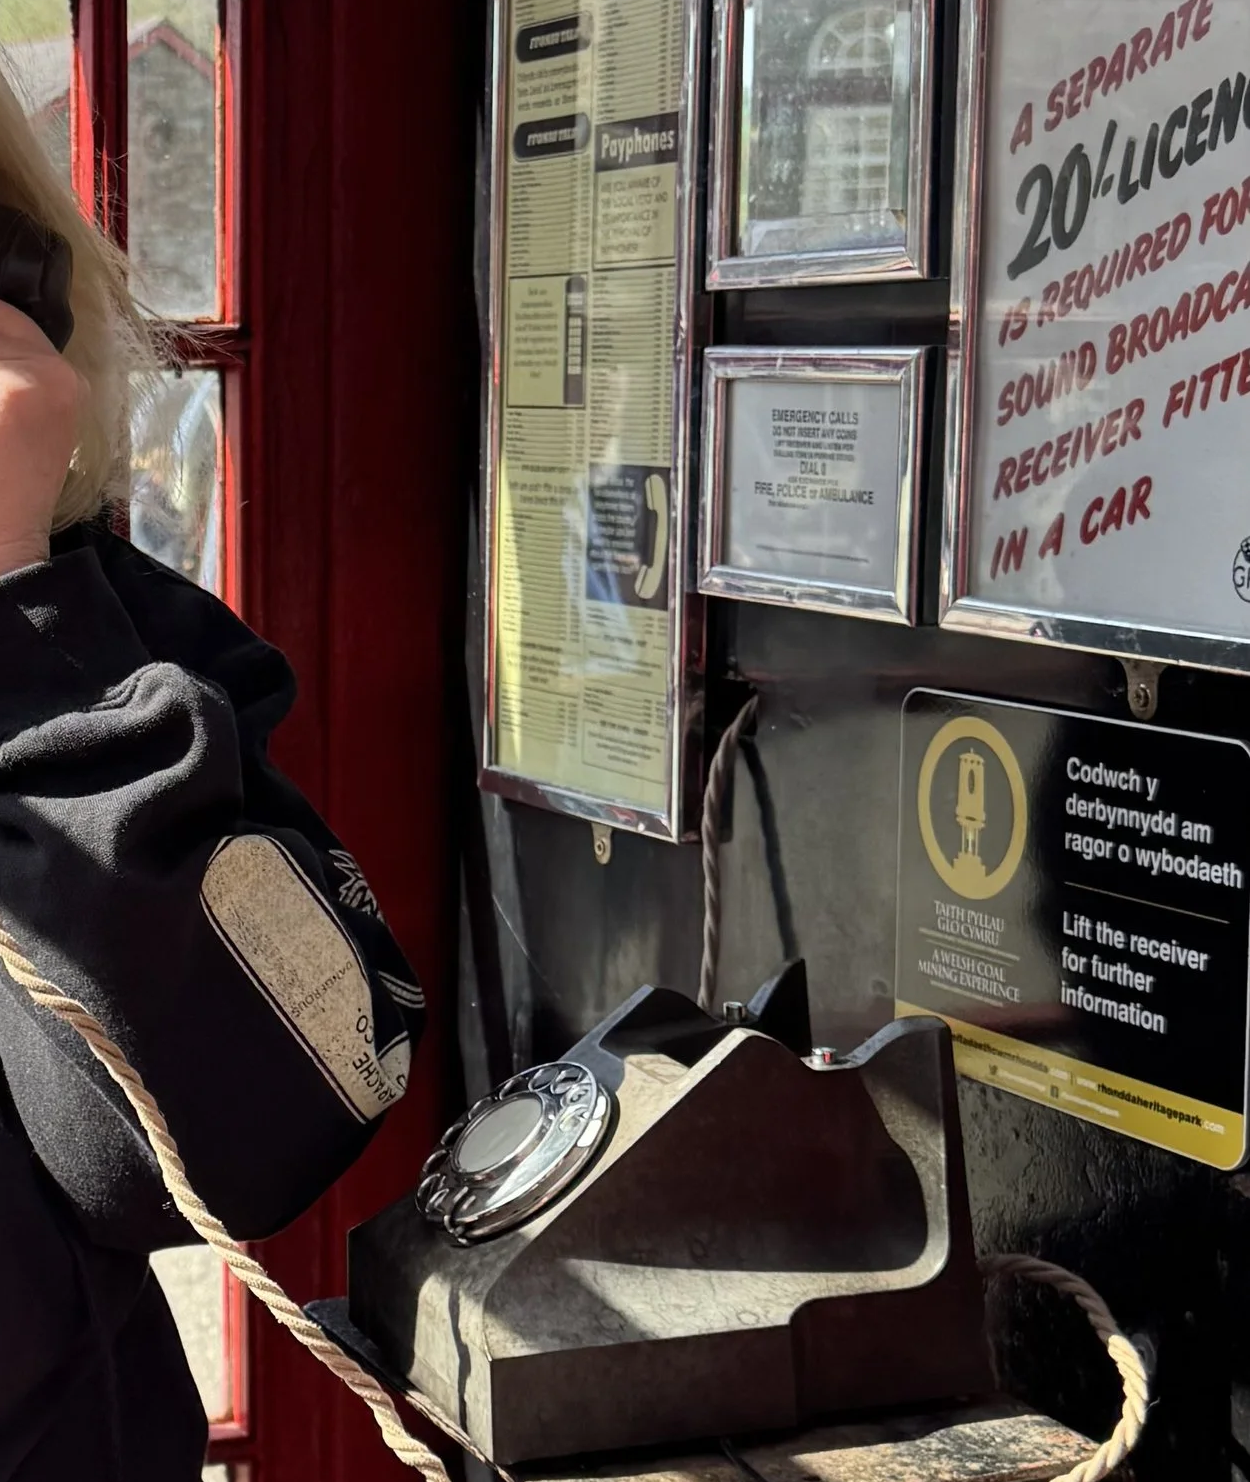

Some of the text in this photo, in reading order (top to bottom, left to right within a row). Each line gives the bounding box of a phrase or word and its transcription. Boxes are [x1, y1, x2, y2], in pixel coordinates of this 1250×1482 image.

[601, 126, 676, 165] Payphones
[1010, 102, 1033, 155] A
[998, 296, 1030, 347] IS
[1036, 212, 1192, 328] REQUIRED
[997, 341, 1098, 427] SOUND
[771, 408, 859, 425] EMERGENCY CALLS
[993, 398, 1146, 501] RECEIVER
[820, 487, 875, 505] AMBULANCE
[990, 475, 1153, 581] IN A CAR
[1067, 756, 1159, 801] Codwch y
[1065, 792, 1214, 844] derbynnydd am
[1065, 831, 1244, 889] ragor o wybodaeth
[934, 900, 965, 922] TAITH
[937, 917, 999, 946] GLO CYMRU
[931, 949, 1007, 983] A WELSH COAL
[1062, 911, 1211, 971] Lift the receiver
[918, 959, 1021, 1003] MINING EXPERIENCE
[1061, 946, 1155, 993] for further
[1061, 981, 1167, 1034] information
[352, 1051, 397, 1105] APACHE
